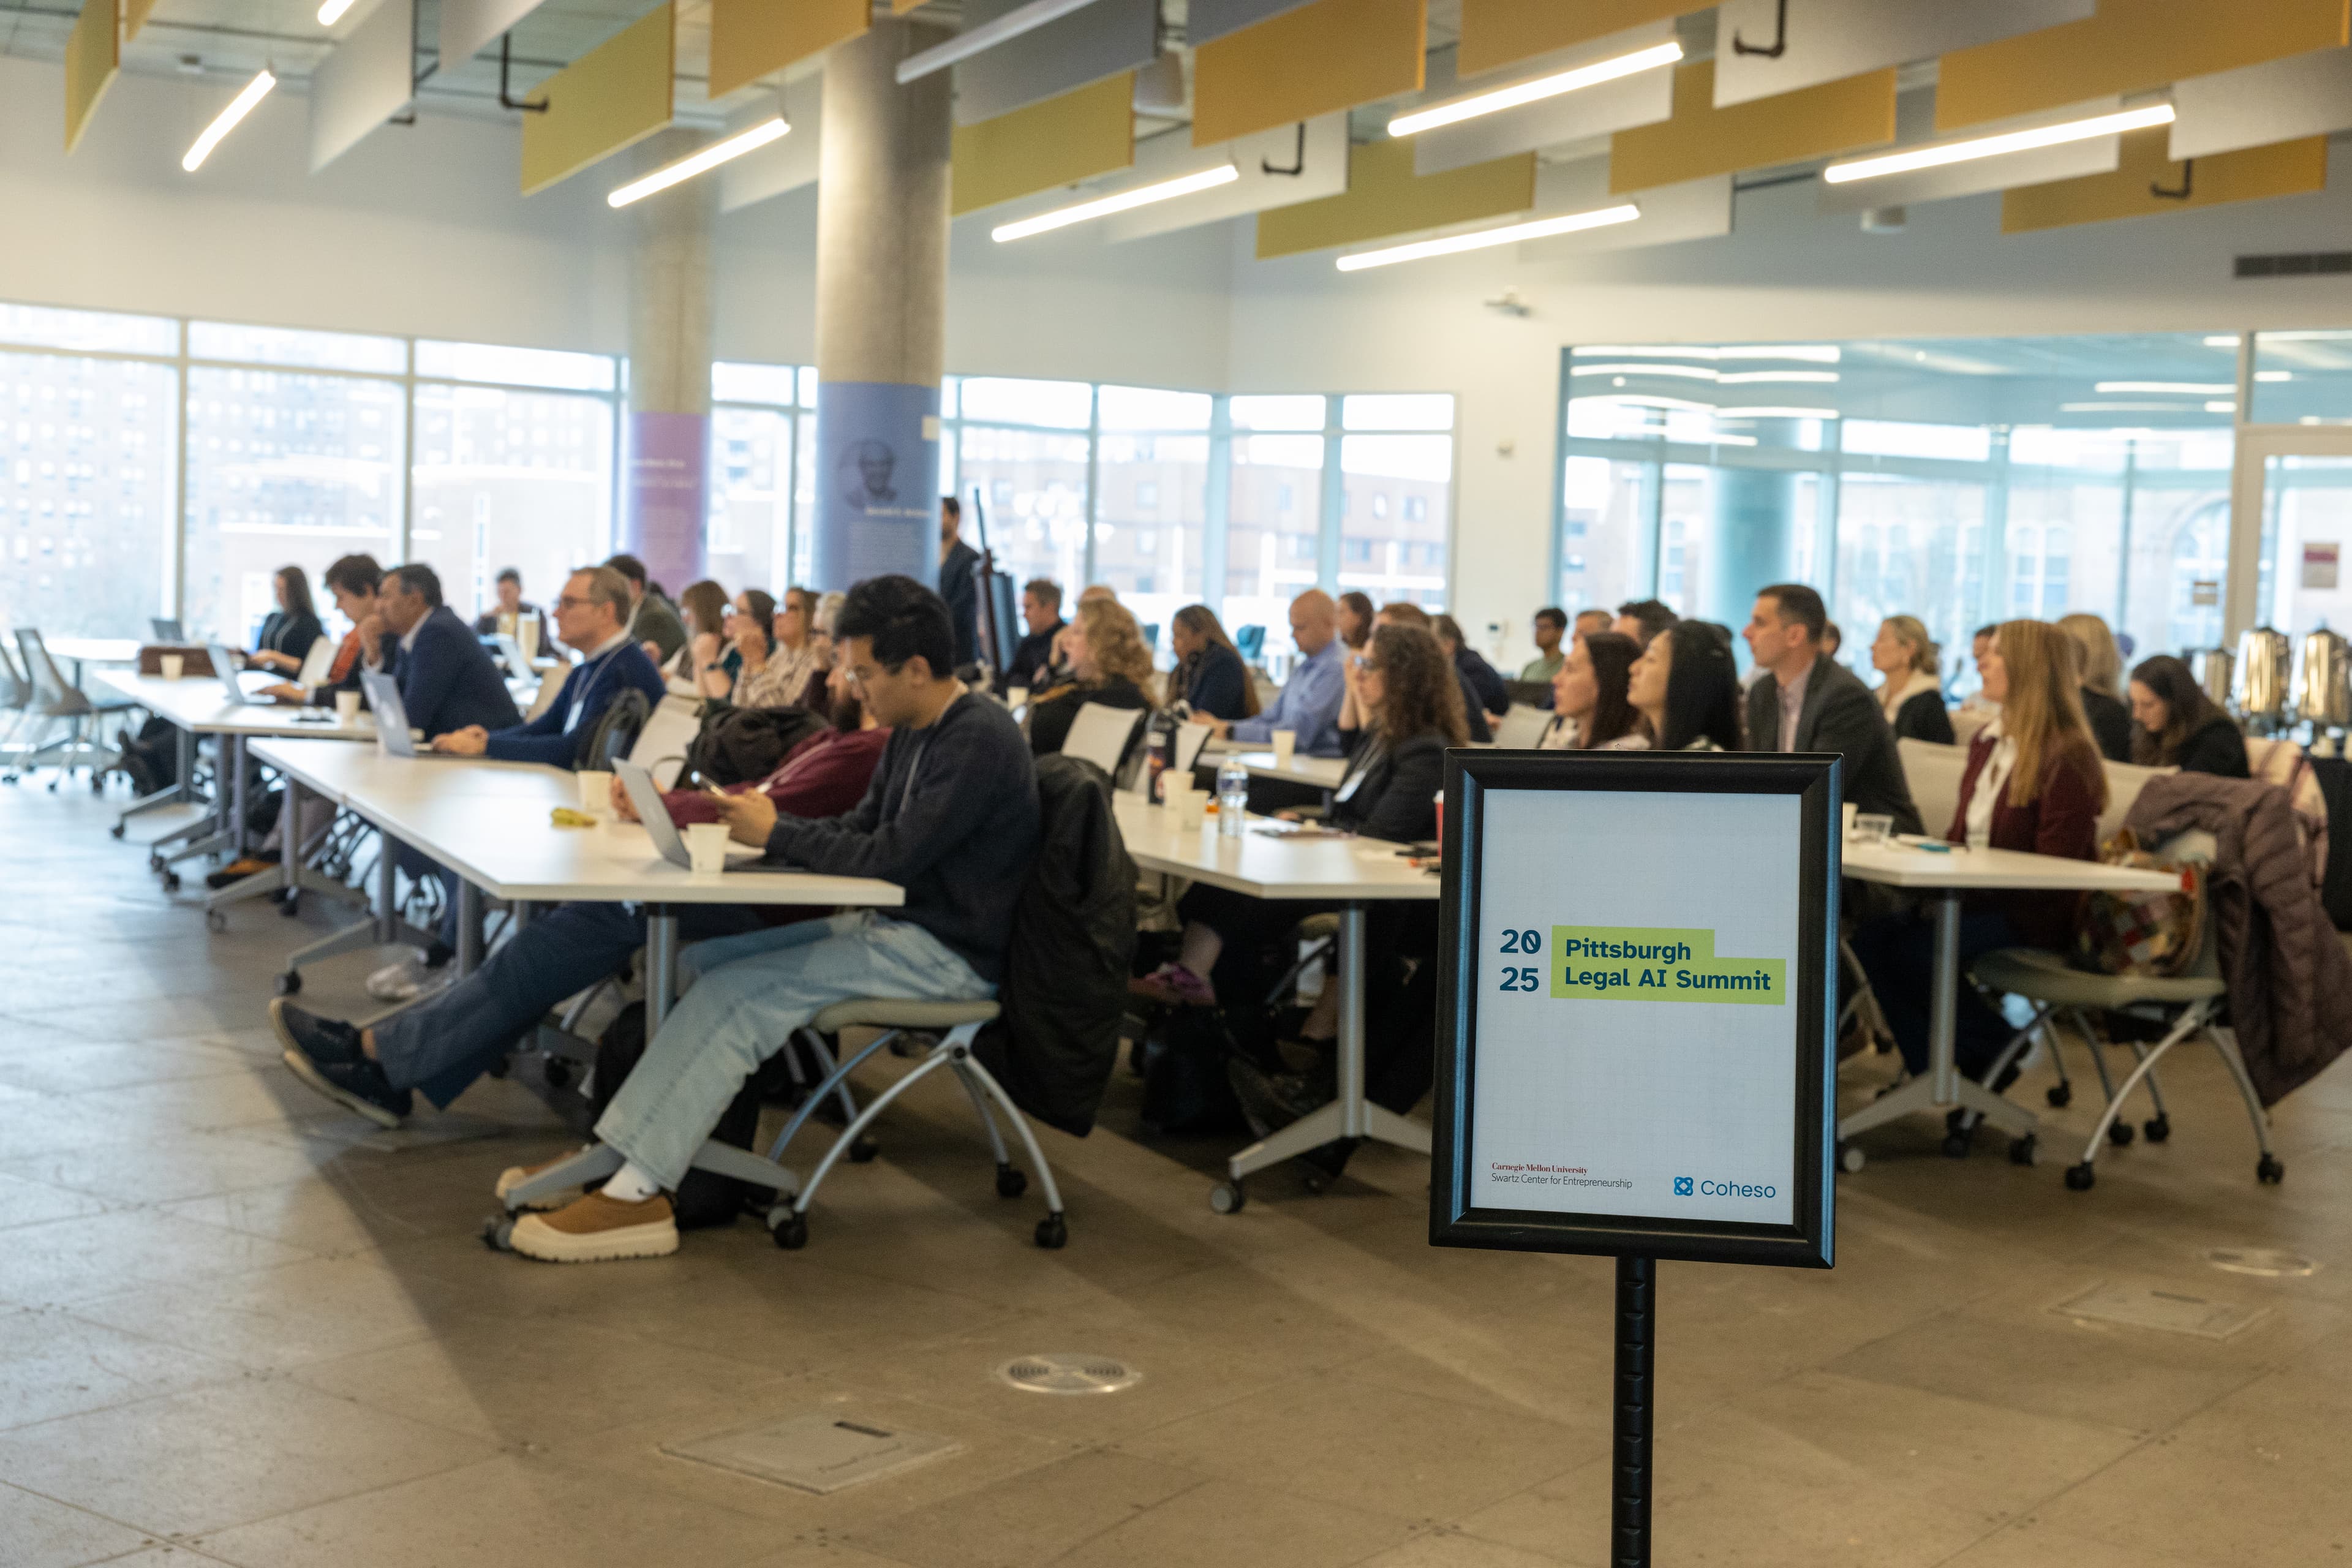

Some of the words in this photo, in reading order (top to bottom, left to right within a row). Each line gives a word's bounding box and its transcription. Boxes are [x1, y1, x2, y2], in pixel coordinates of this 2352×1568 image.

[1499, 929, 1542, 955] 20
[1566, 937, 1691, 965] Pittsburgh
[1499, 966, 1540, 992] 25
[1565, 966, 1631, 991] Legal
[1637, 968, 1667, 988] AI
[1675, 969, 1772, 991] Summit
[1491, 1162, 1525, 1172] Carnegie
[1526, 1164, 1551, 1172] Mellon
[1552, 1165, 1588, 1176] University
[1491, 1172, 1520, 1183] Swartz
[1521, 1174, 1549, 1185] Center
[1550, 1175, 1561, 1185] for
[1563, 1176, 1632, 1190] Entrepreneurship
[1700, 1180, 1777, 1199] Coheso
